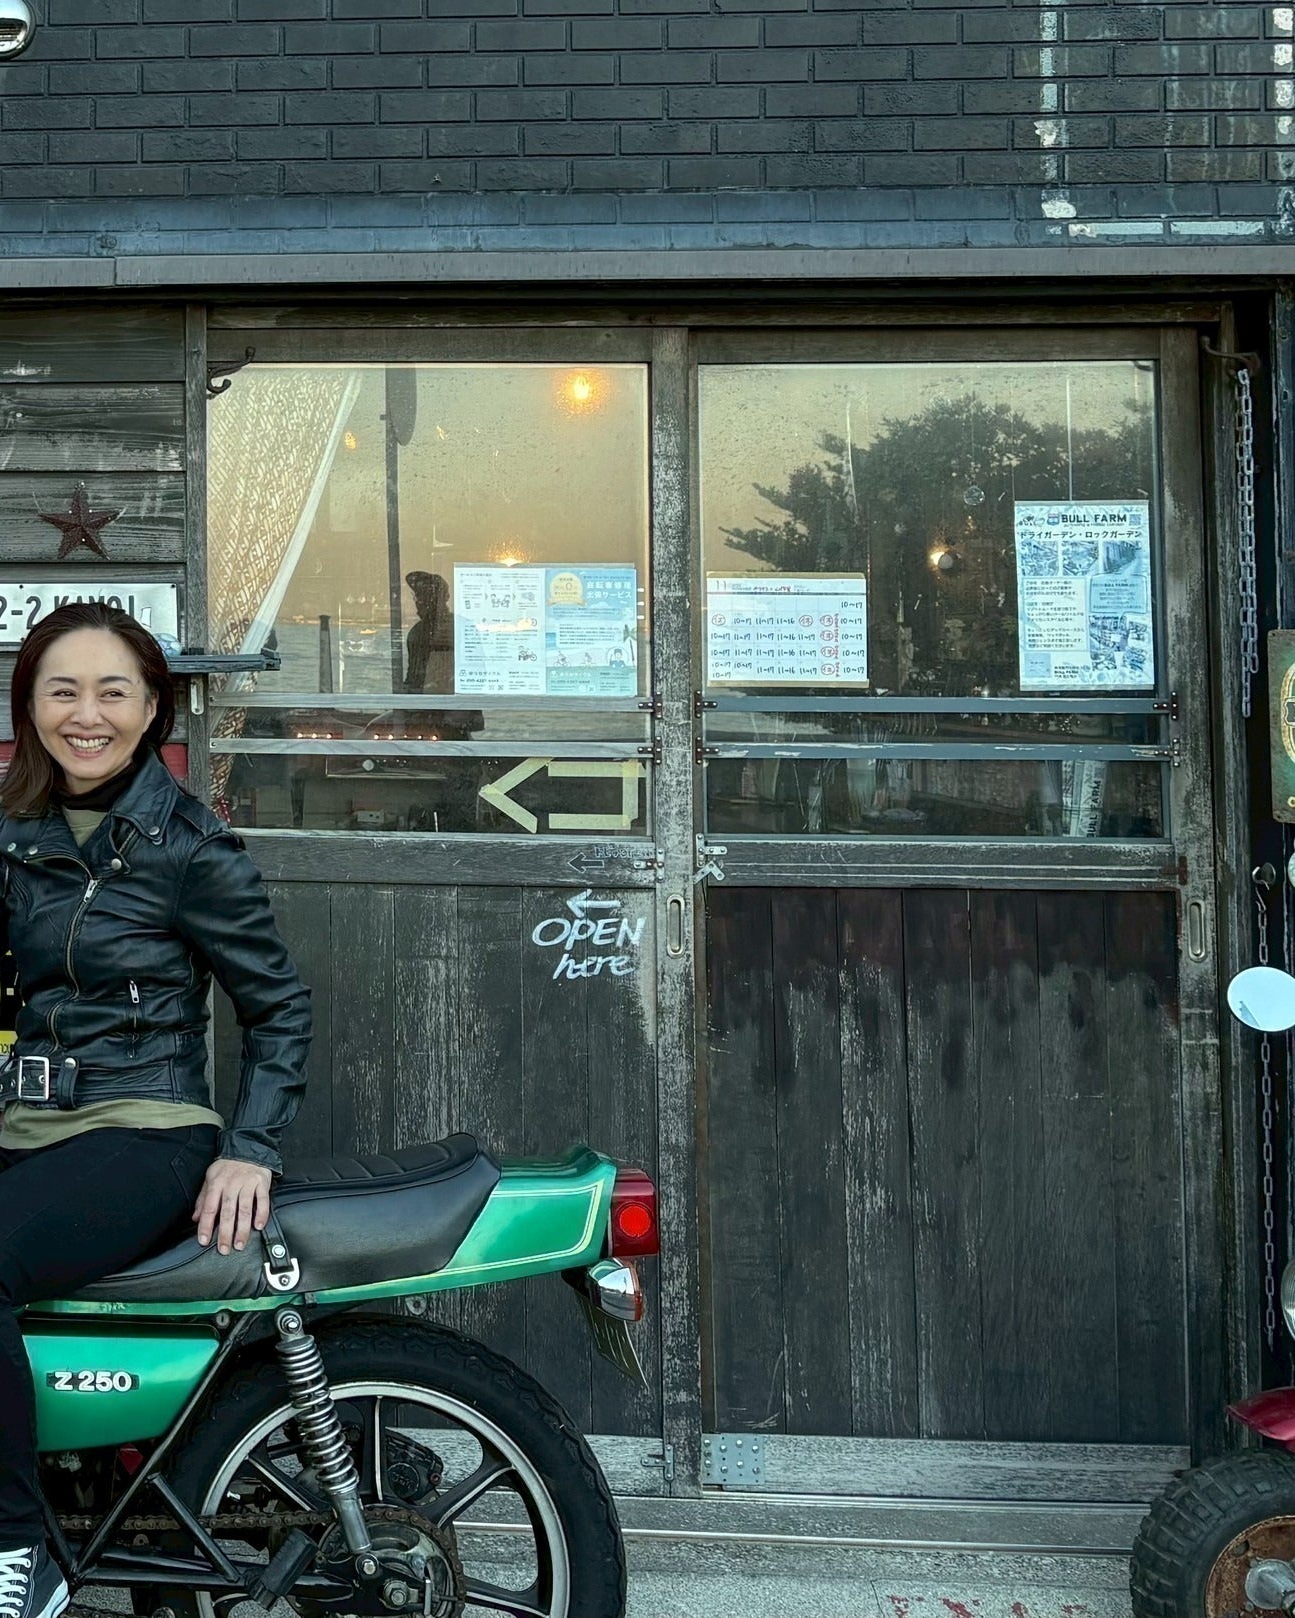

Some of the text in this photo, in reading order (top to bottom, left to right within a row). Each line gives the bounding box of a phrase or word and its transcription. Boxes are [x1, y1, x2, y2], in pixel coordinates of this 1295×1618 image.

[1061, 514, 1127, 523] BULL FARM
[1090, 780, 1102, 812] FARM
[532, 917, 647, 951] OPEN
[552, 953, 636, 980] here
[54, 1370, 132, 1392] Z 250
